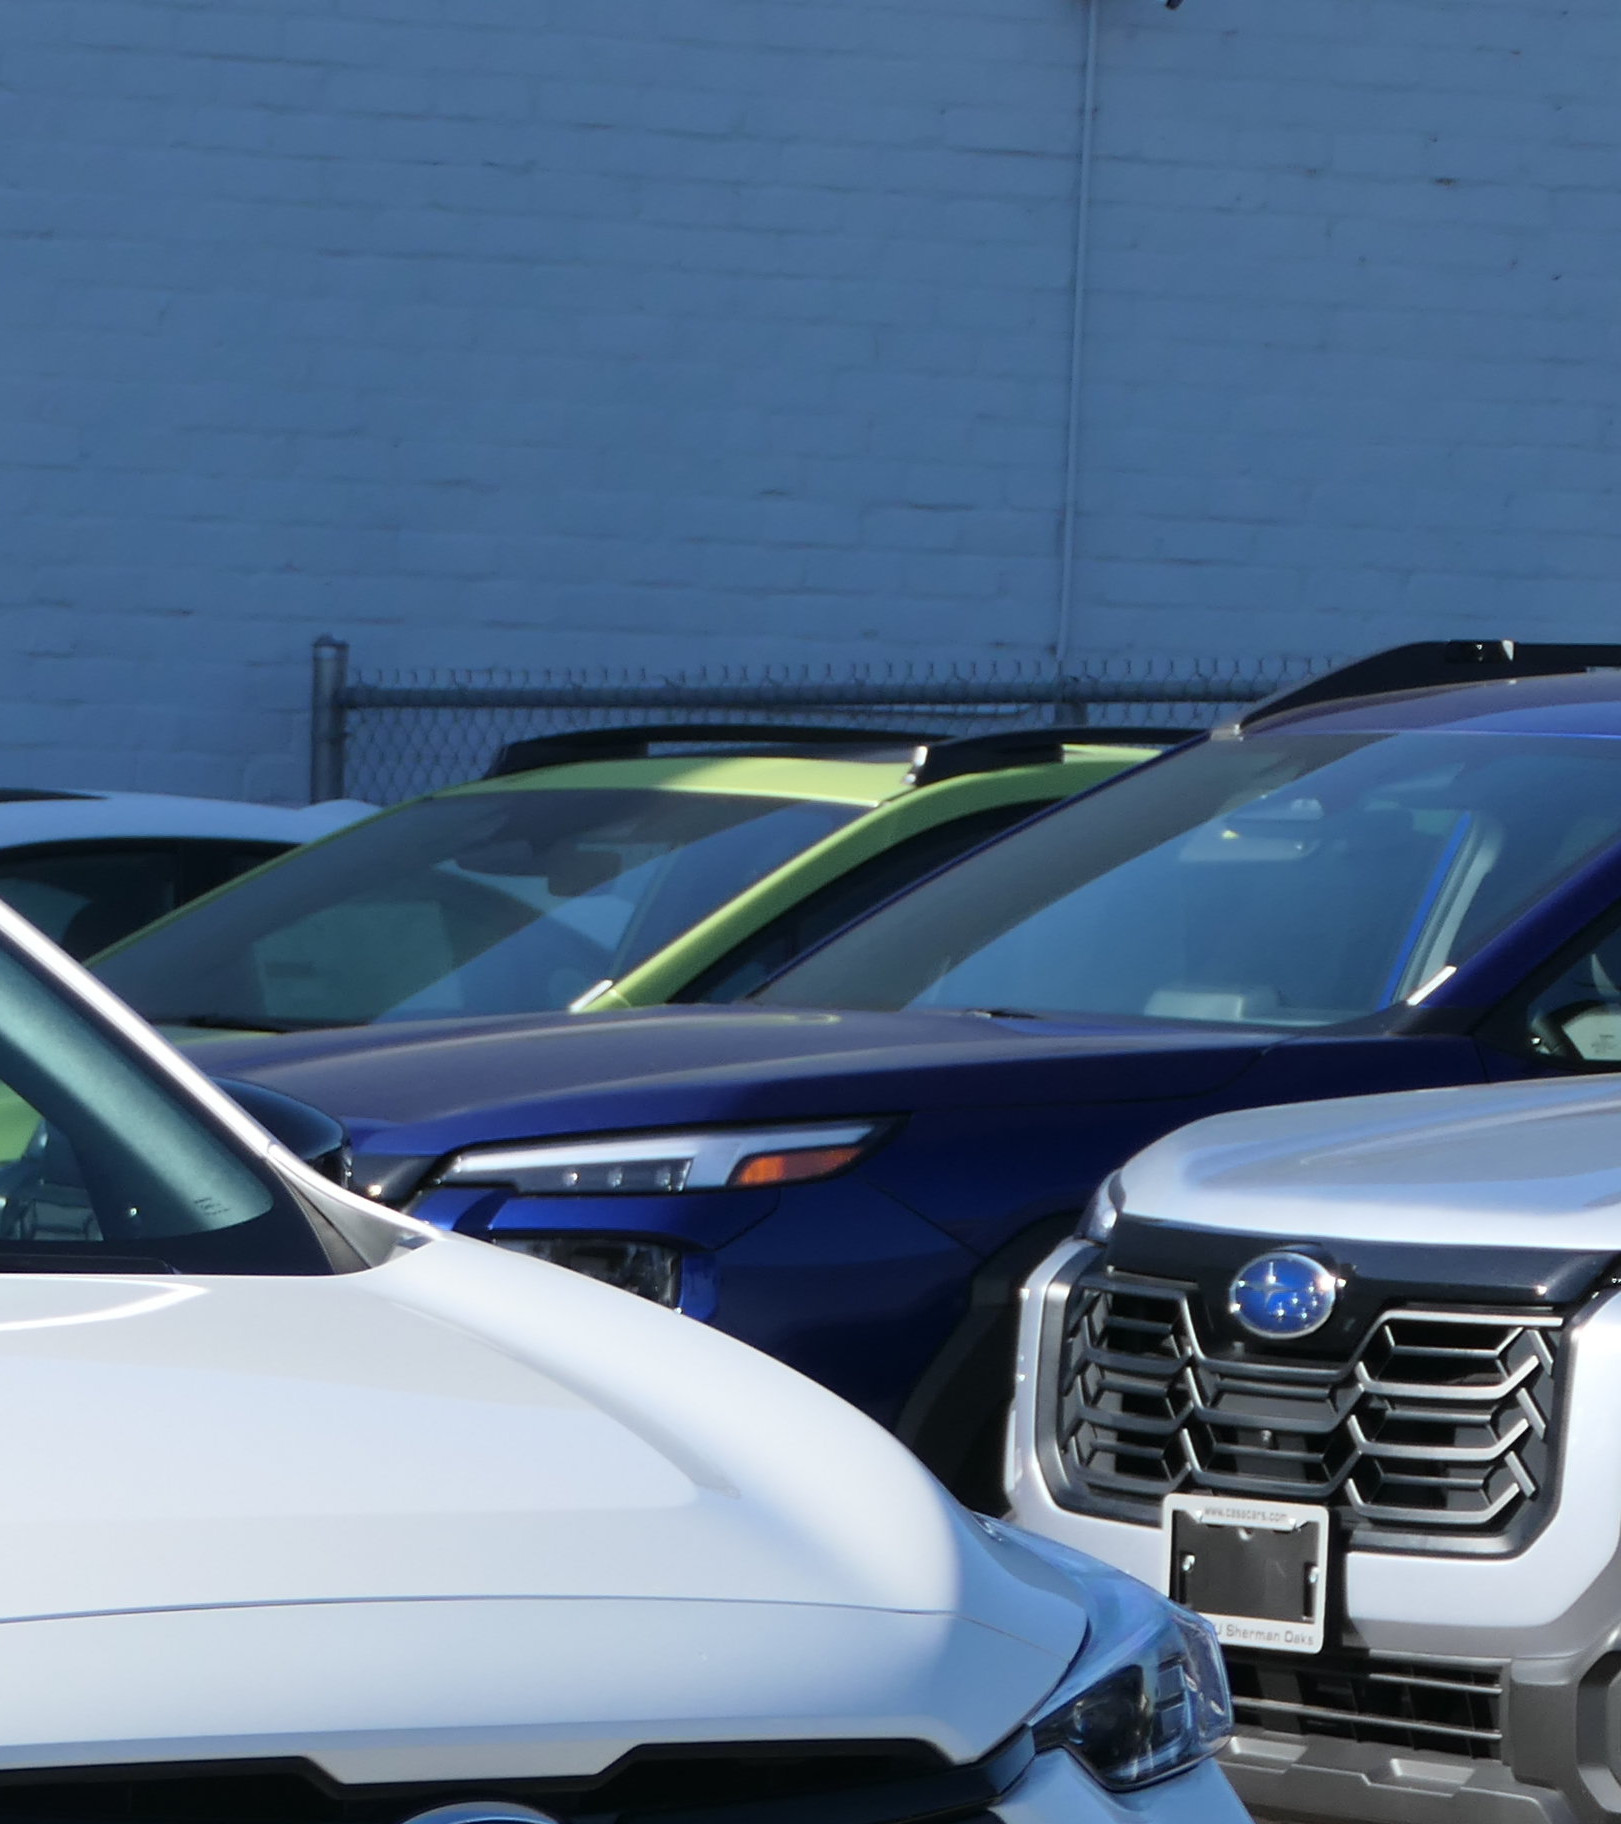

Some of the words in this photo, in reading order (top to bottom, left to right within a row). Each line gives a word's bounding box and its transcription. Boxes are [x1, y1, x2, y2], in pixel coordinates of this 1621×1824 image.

[1204, 1507, 1289, 1522] www.casacars.com
[1226, 1624, 1280, 1643] Sherman
[1284, 1630, 1314, 1646] Oaks
